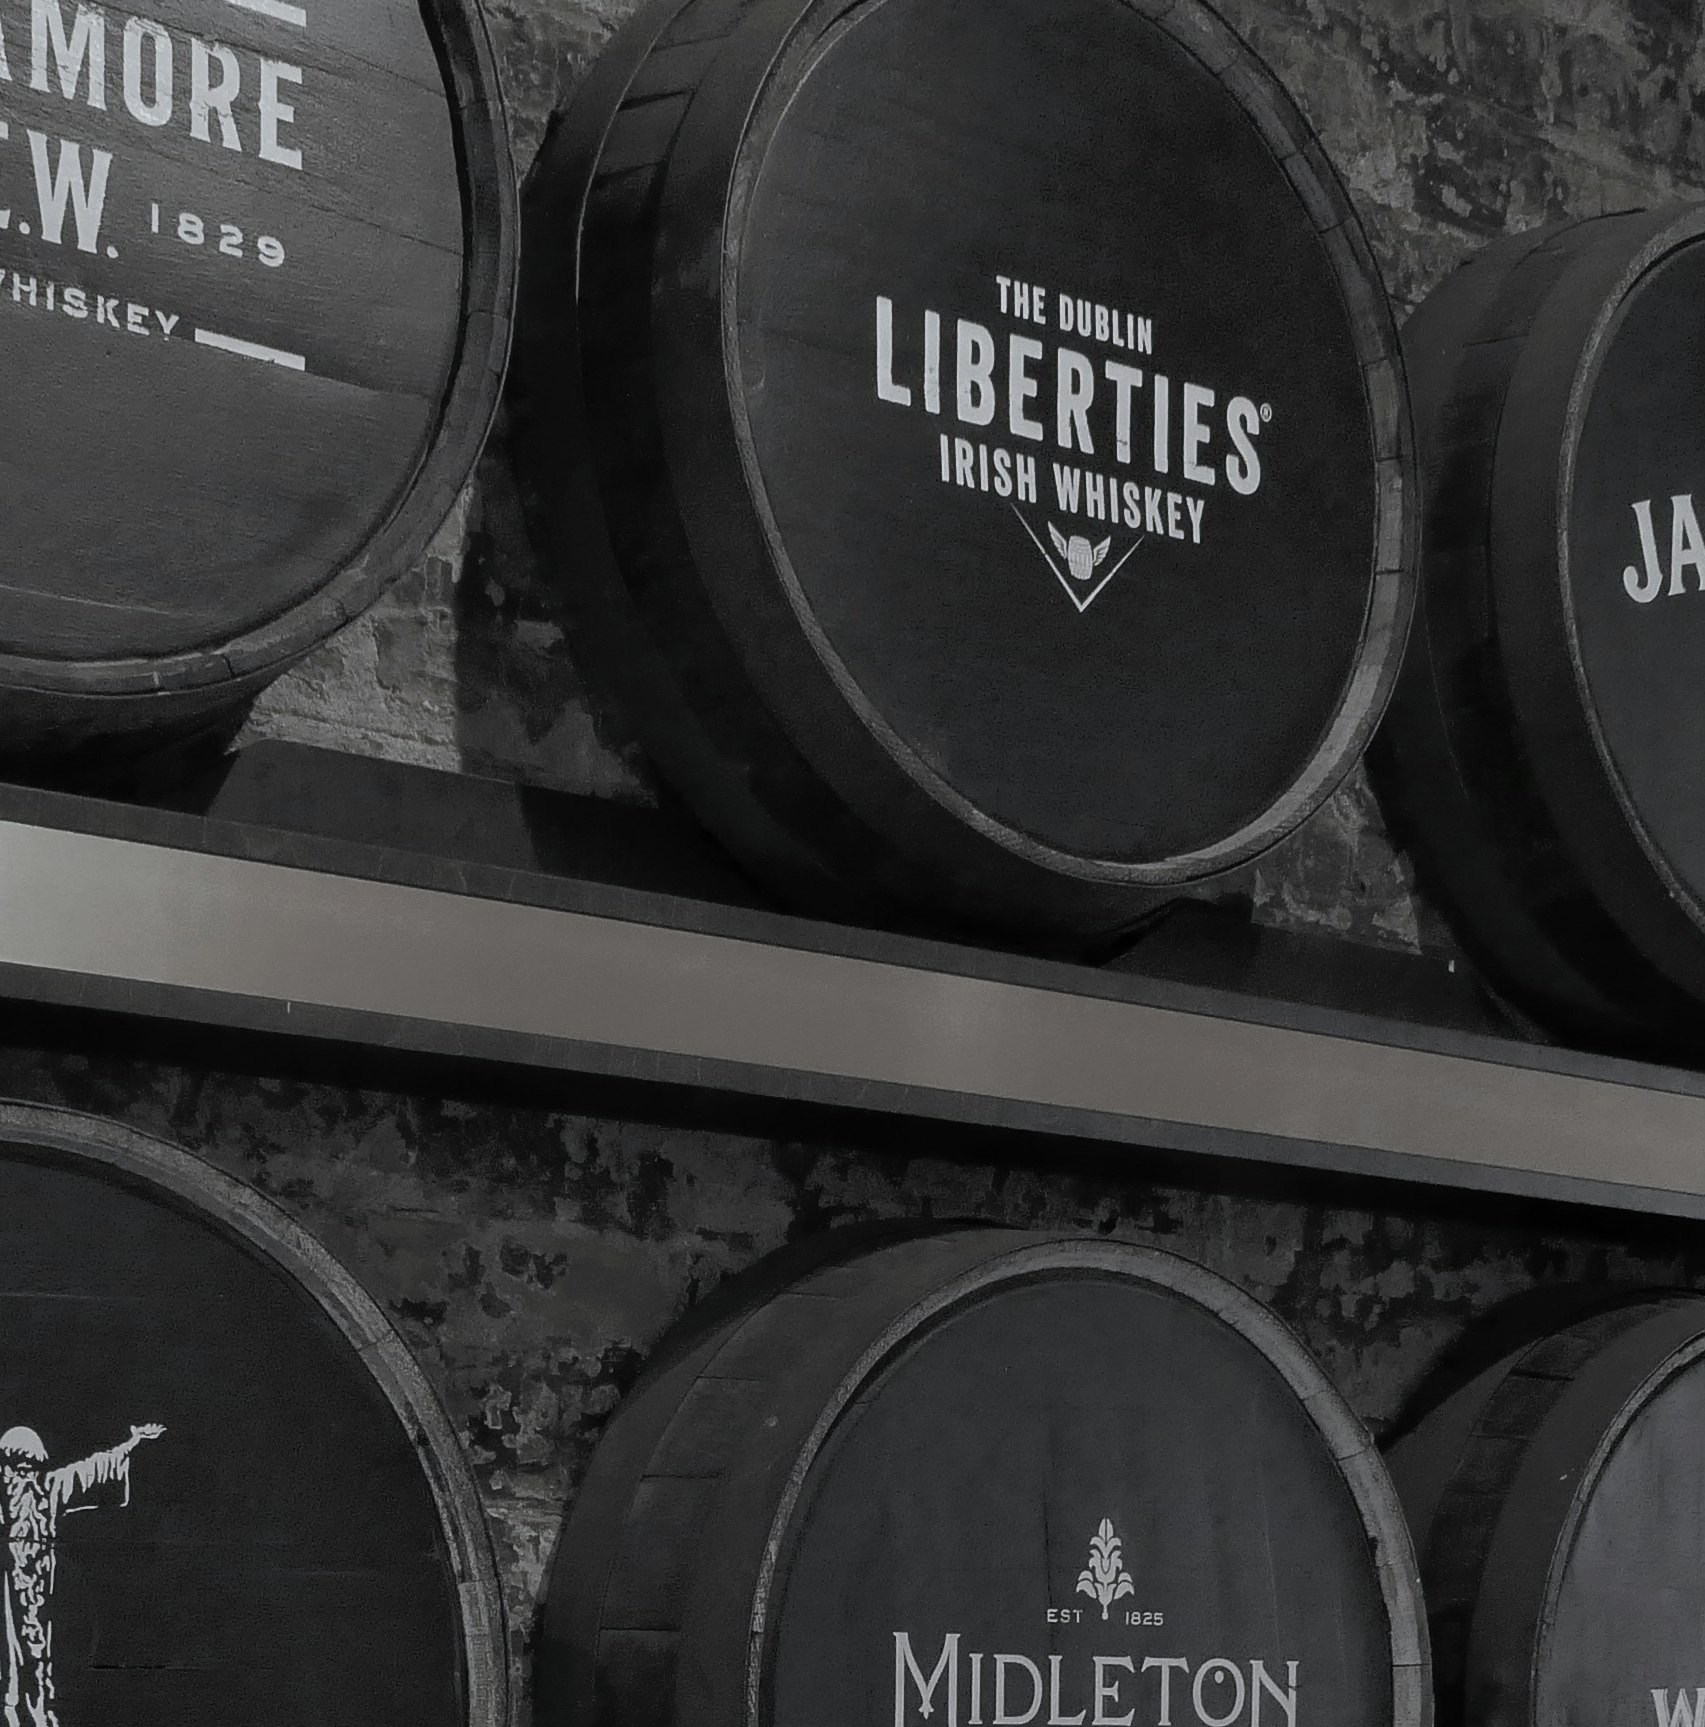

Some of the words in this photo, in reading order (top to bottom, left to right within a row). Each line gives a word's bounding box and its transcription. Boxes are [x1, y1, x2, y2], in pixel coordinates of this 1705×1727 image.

[150, 203, 287, 267] 1829
[997, 276, 1045, 324] THE
[1059, 294, 1152, 354] DUBLIN
[876, 296, 1261, 495] LIBERTIES
[940, 434, 1037, 503] IRISH
[1053, 462, 1205, 544] WHISKEY
[1047, 1609, 1083, 1623] EST
[1125, 1611, 1164, 1626] 1825
